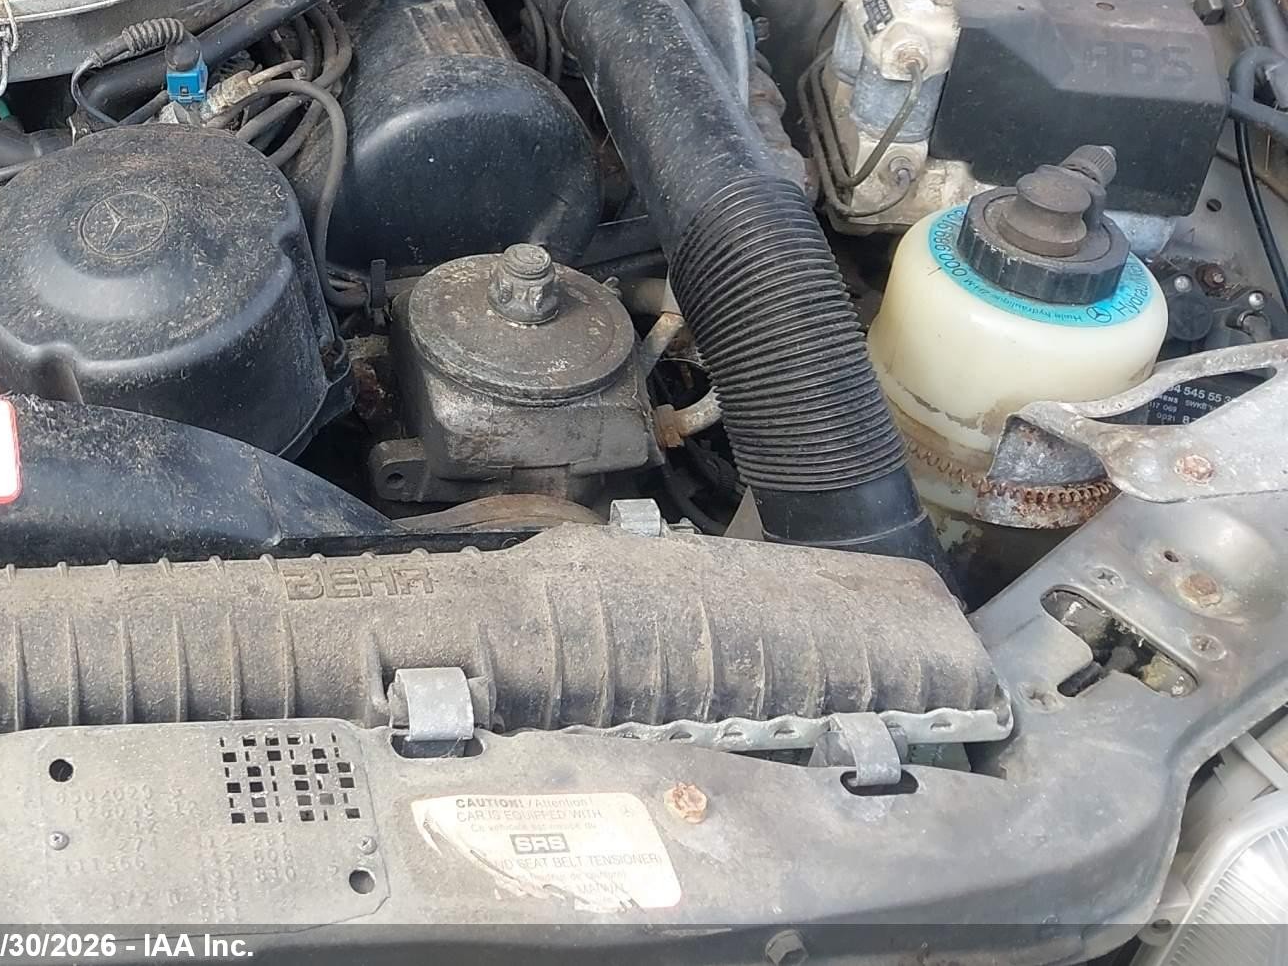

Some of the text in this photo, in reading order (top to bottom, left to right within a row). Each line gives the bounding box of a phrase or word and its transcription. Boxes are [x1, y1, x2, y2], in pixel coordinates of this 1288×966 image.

[1083, 41, 1193, 82] ABS
[1183, 386, 1206, 399] 545
[1207, 392, 1223, 403] 55
[282, 565, 435, 600] BEHR
[455, 798, 525, 809] CAUTION!
[456, 809, 602, 823] CAR IS EQUIPPED WITH
[514, 835, 567, 852] SRS
[518, 858, 549, 870] SEAT
[553, 856, 584, 868] BELT
